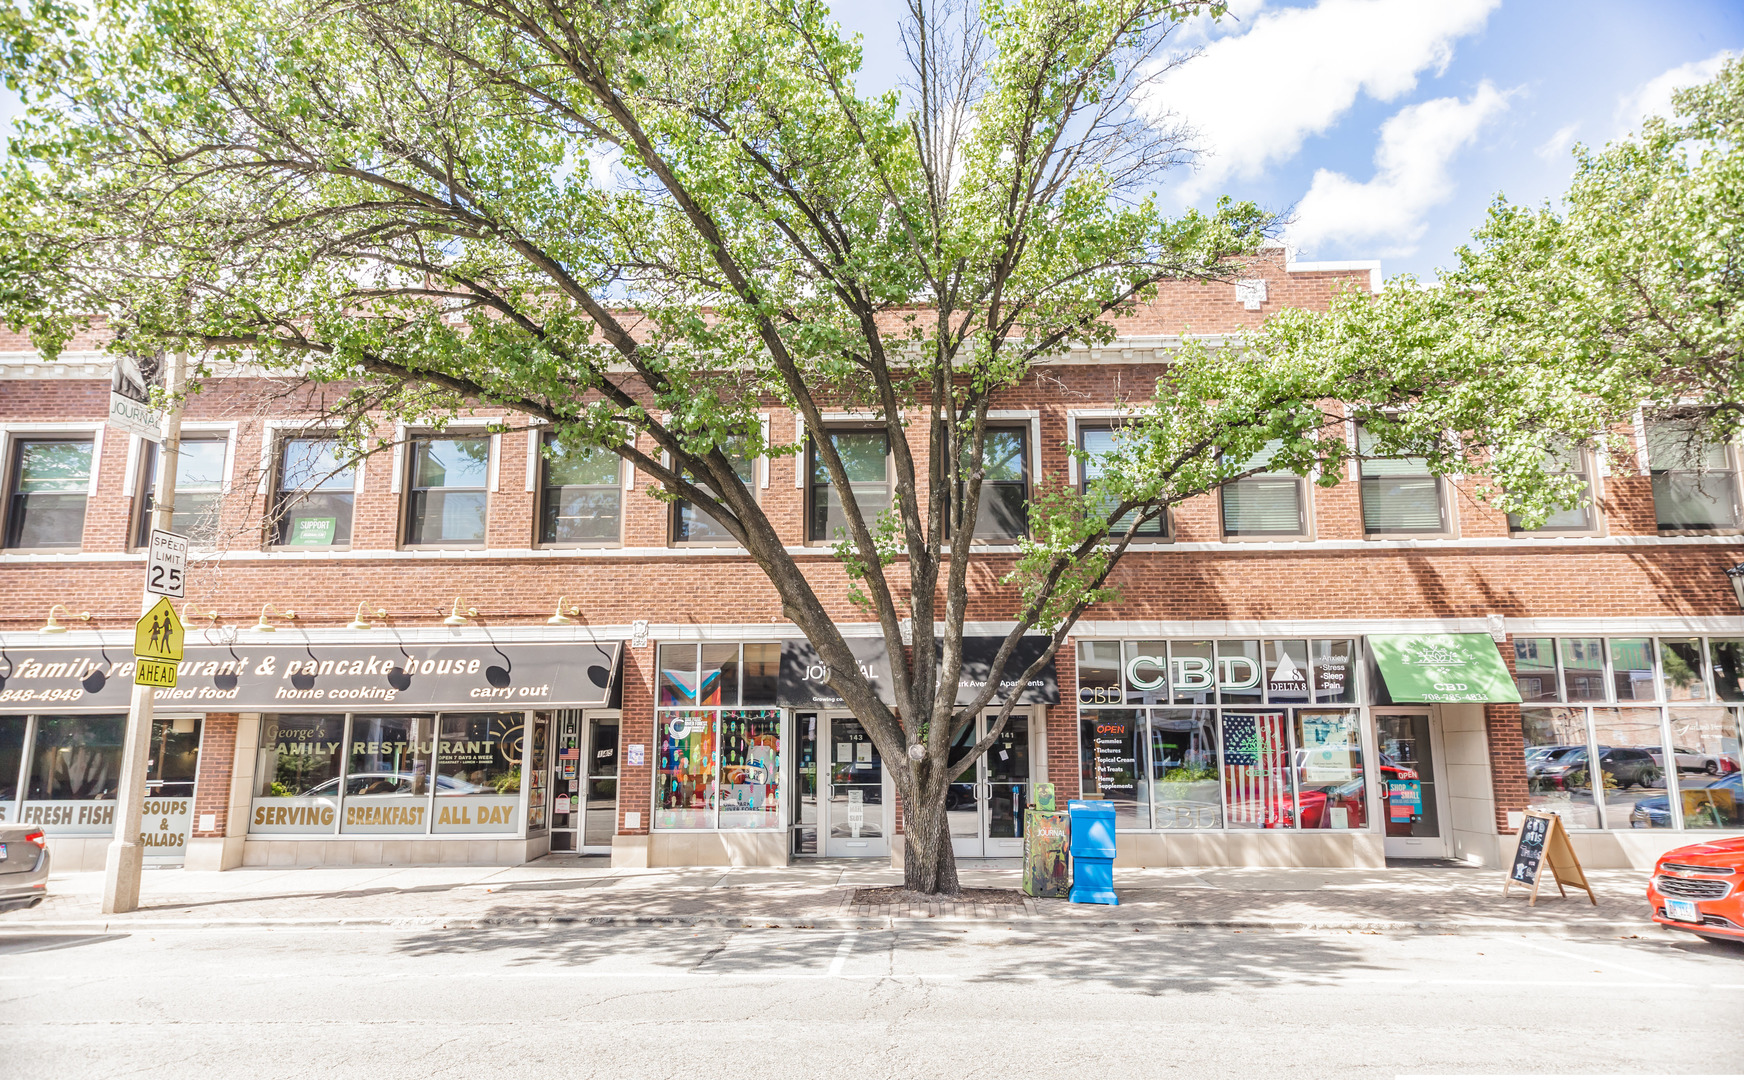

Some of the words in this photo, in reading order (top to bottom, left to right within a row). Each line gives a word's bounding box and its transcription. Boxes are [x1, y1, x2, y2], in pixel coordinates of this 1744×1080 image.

[111, 400, 161, 430] JOURNAL
[300, 520, 330, 530] SUPPORT
[154, 536, 185, 552] SPEED
[156, 551, 180, 564] LIMIT
[151, 565, 181, 590] 25
[13, 658, 103, 681] family
[106, 657, 249, 678] reurant
[254, 656, 276, 675] &
[283, 656, 395, 679] pancake
[402, 656, 480, 675] house
[138, 664, 175, 683] AHEAD
[1126, 656, 1261, 691] CBD
[0, 688, 83, 702] 848-4949
[198, 687, 240, 699] food
[275, 686, 324, 699] home
[328, 687, 398, 701] cooking
[469, 687, 516, 699] carry
[519, 684, 549, 697] out
[1271, 683, 1300, 691] DELTA
[1301, 683, 1307, 691] 8
[1433, 683, 1468, 691] CBD
[1079, 686, 1122, 704] CBD
[267, 724, 326, 741] George's
[1097, 725, 1125, 734] OPEN
[265, 742, 340, 755] FAMILY
[352, 741, 495, 755] RESTAURANT
[1398, 771, 1418, 779] OPEN
[1390, 783, 1406, 791] SHOP
[1400, 791, 1420, 799] SMALL
[24, 806, 73, 825] FRESH
[78, 805, 115, 825] FISH
[142, 801, 187, 816] SOUPS
[254, 806, 335, 825] SERVING
[346, 806, 425, 825] BREAKFAST
[438, 806, 471, 825] ALL
[477, 805, 514, 825] DAY
[159, 817, 169, 830] &
[1155, 805, 1216, 829] CBD
[139, 832, 184, 848] SALADS
[1037, 829, 1066, 837] JOURNAL
